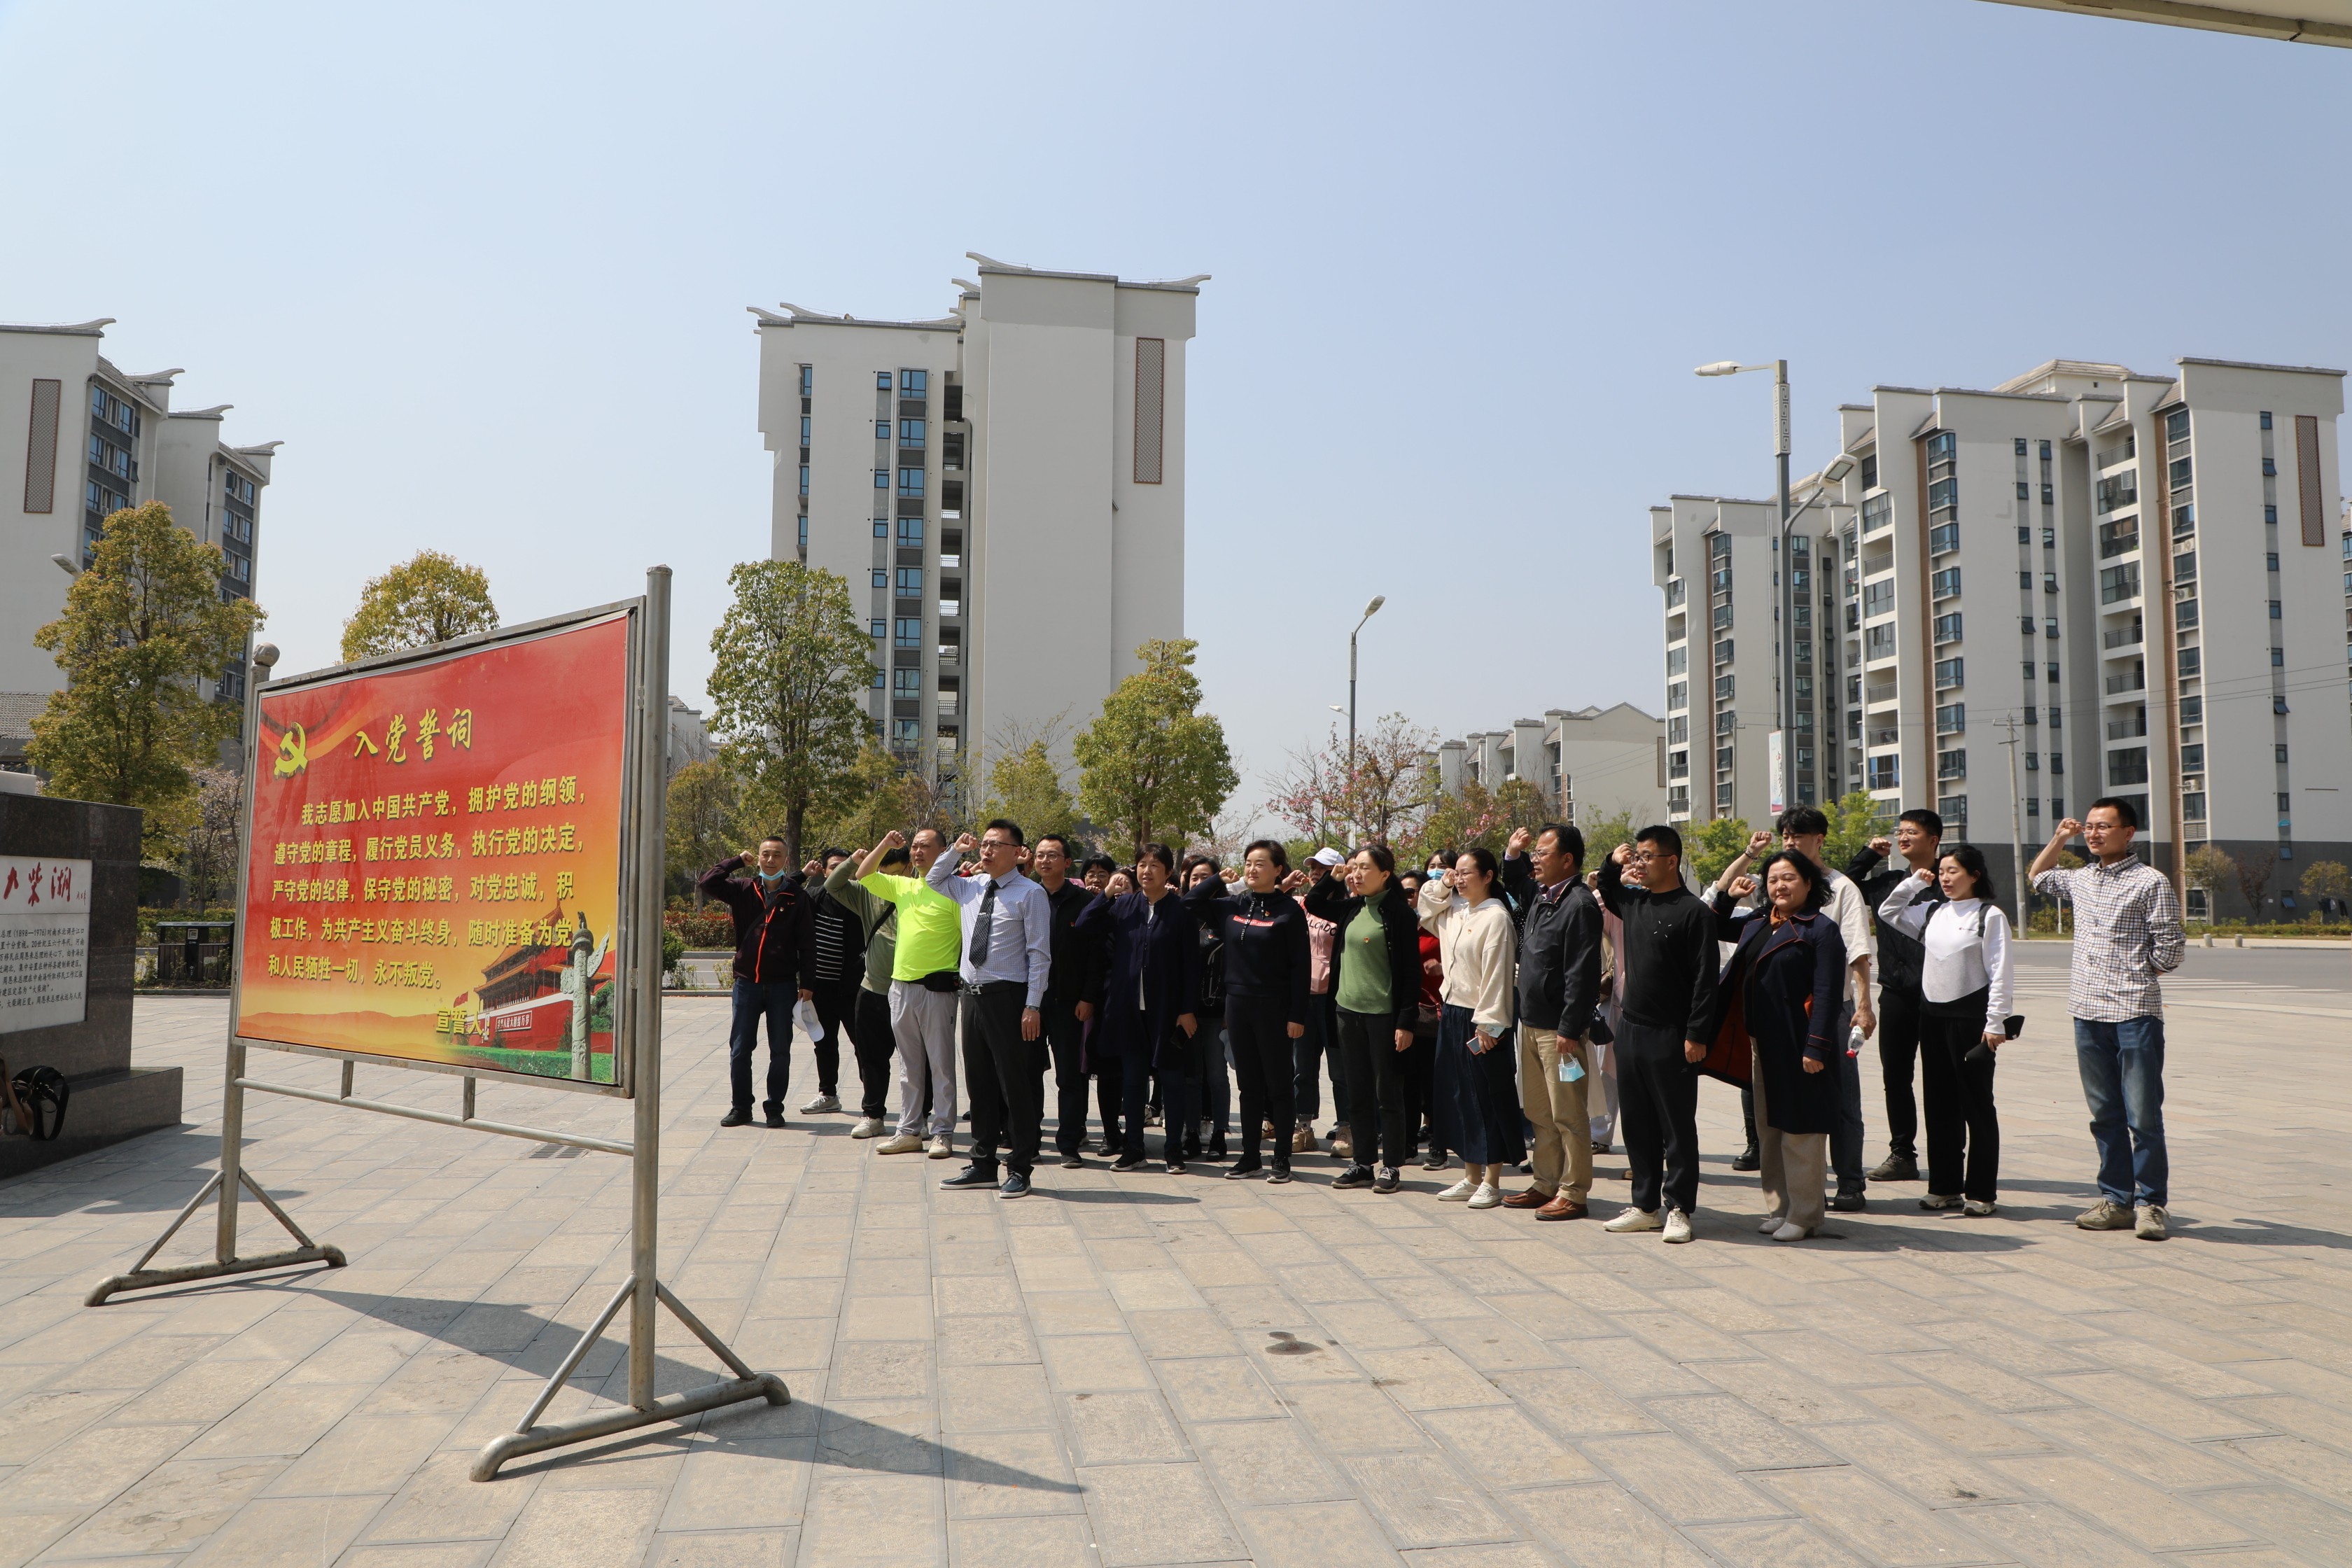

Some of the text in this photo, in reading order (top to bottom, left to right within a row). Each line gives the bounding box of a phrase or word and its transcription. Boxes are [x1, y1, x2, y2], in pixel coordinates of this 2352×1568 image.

[354, 708, 472, 763] 入党誓词
[302, 775, 584, 826] 我志愿加入中国共产党，拥护党的纲领，
[274, 822, 583, 865] 遵守党的章程，履行党员义务，执行党的决定，
[4, 862, 72, 907] 大柴湖
[272, 871, 574, 903] 严守党的纪律，保守党的秘密，对党忠诚，积
[270, 916, 573, 947] 极工作，为共产主义奋斗终身，随时准备为党
[268, 954, 442, 989] 和人民牺牲一切，永不叛党。
[0, 992, 82, 1009] ，大柴湖巨变。周恩来总理永远与人民
